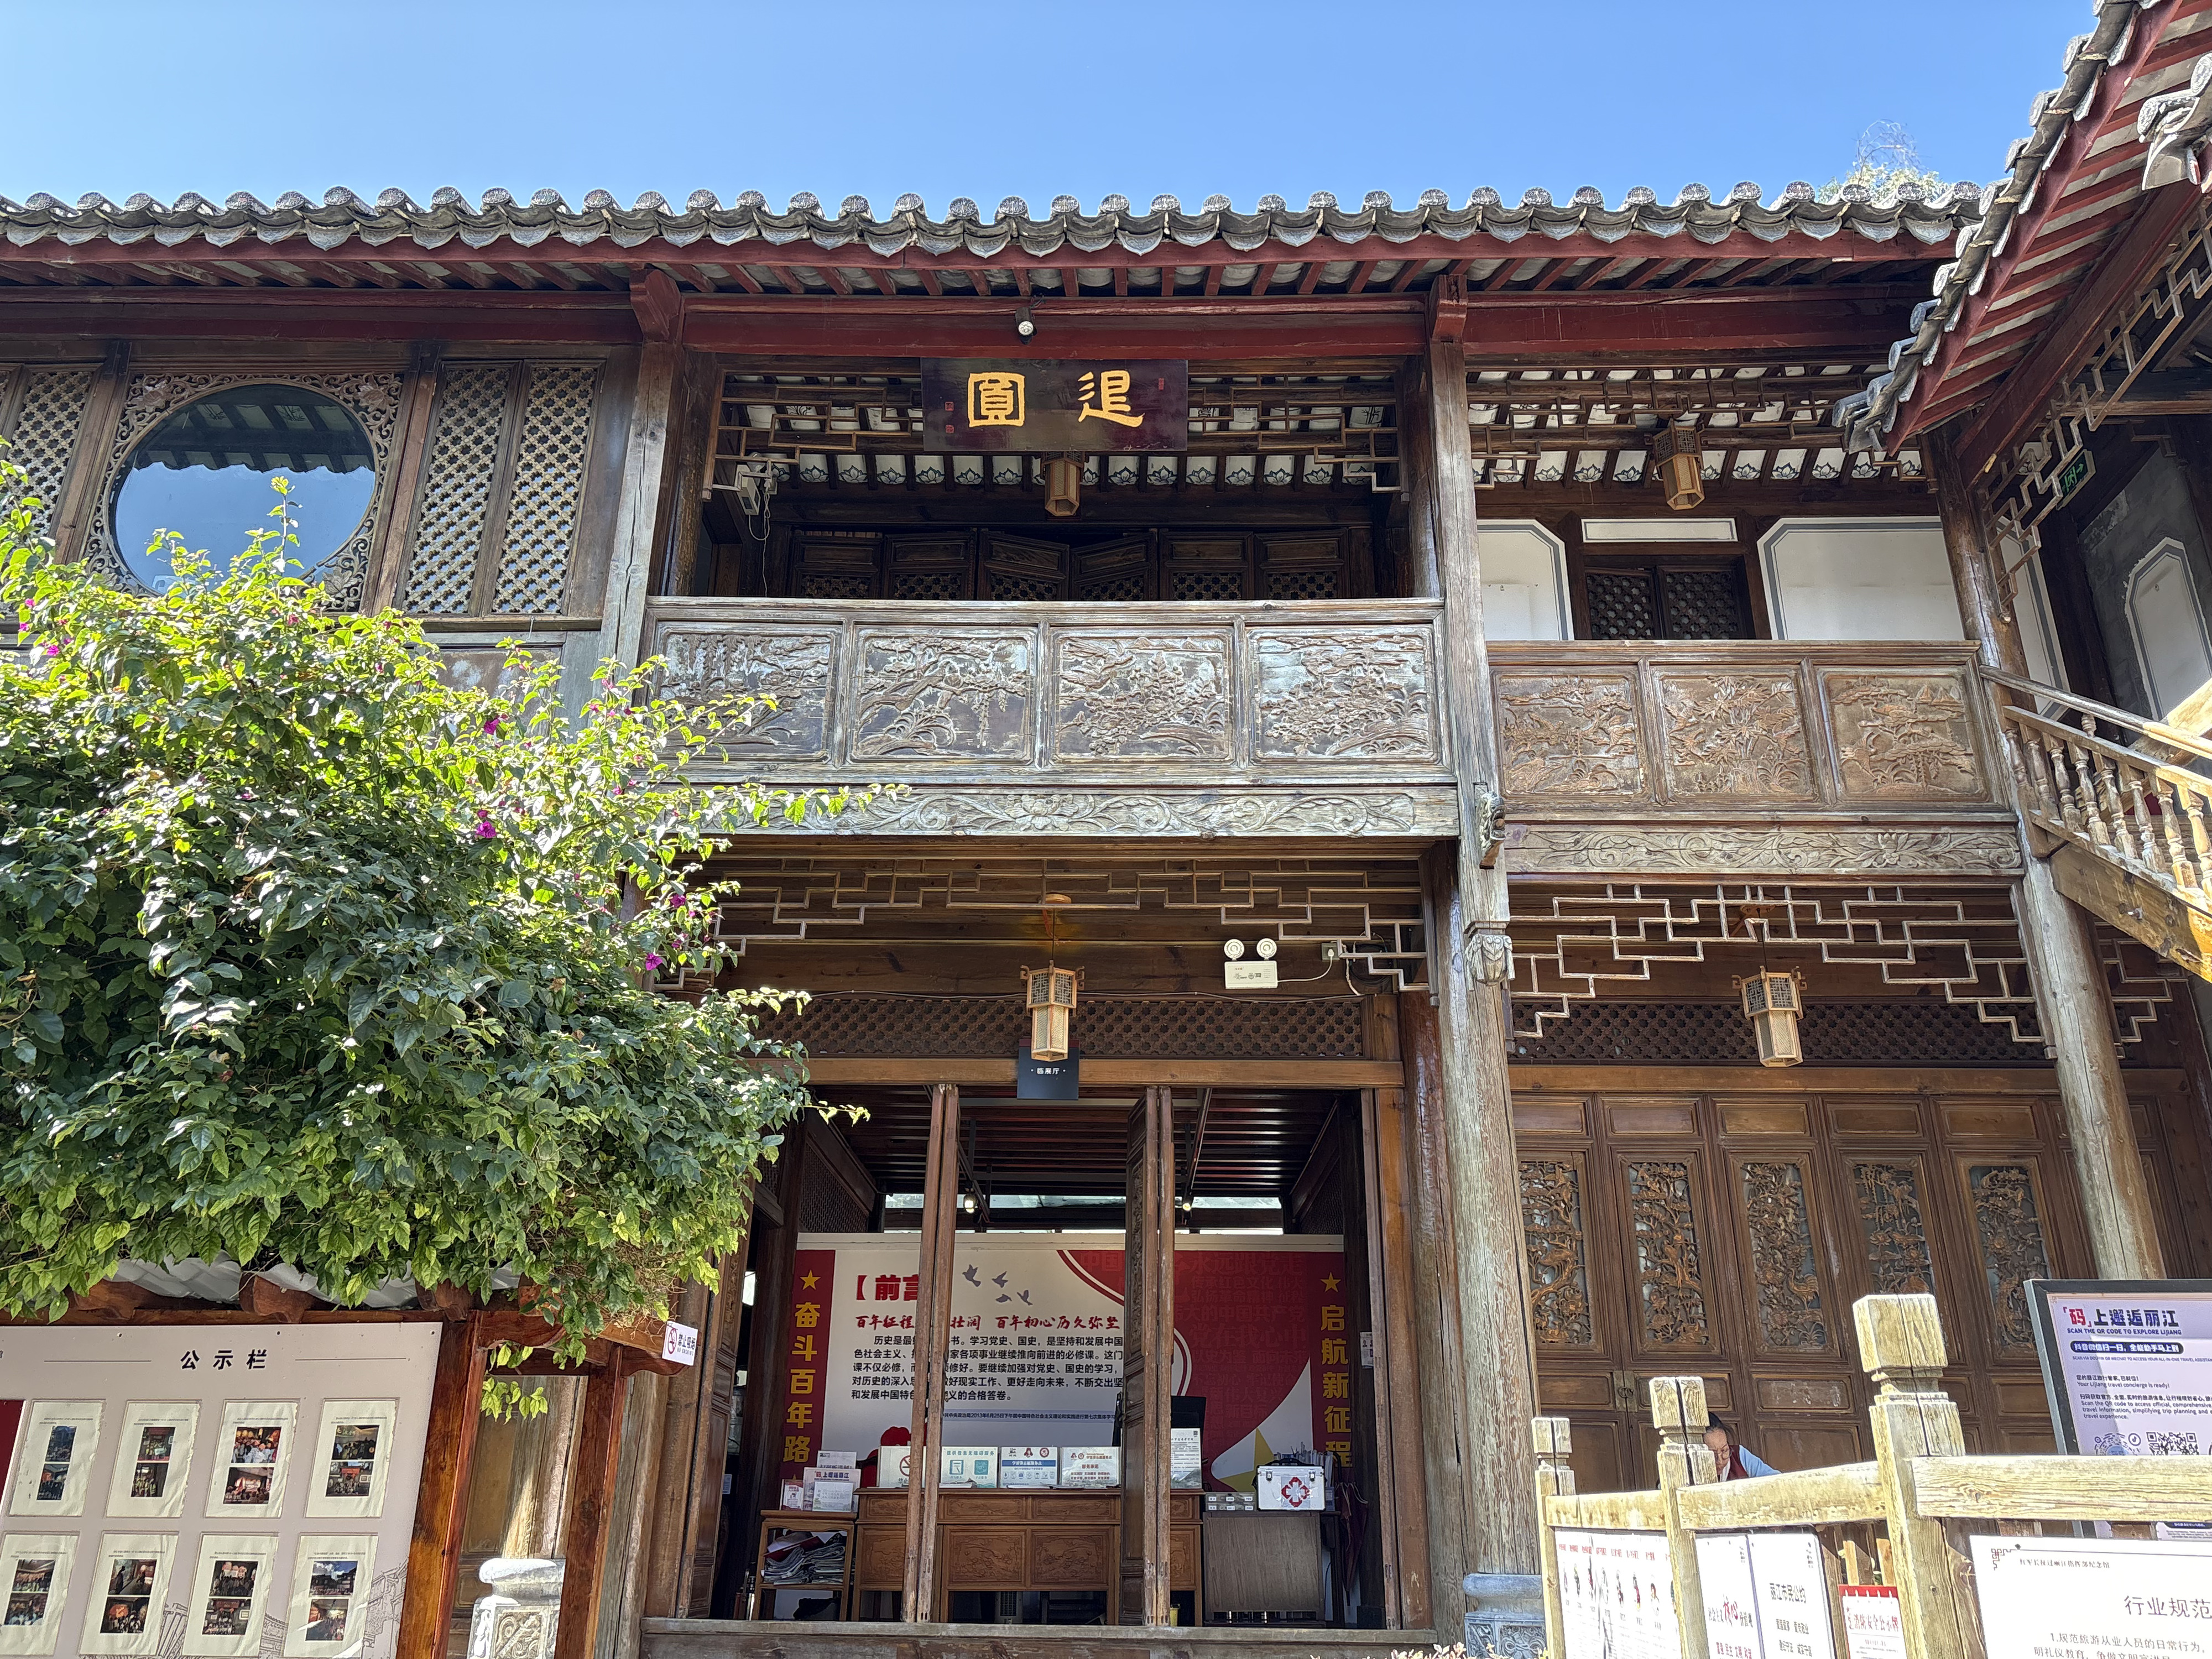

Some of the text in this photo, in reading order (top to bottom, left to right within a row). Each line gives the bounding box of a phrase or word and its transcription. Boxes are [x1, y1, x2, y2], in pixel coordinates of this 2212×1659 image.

[995, 1315, 1120, 1331] 百年初心历久弥坚
[180, 1349, 267, 1370] 公示栏
[783, 1302, 821, 1463] 奋斗百年路
[1321, 1305, 1353, 1467] 启航新征程
[2124, 1595, 2212, 1619] 行业规范
